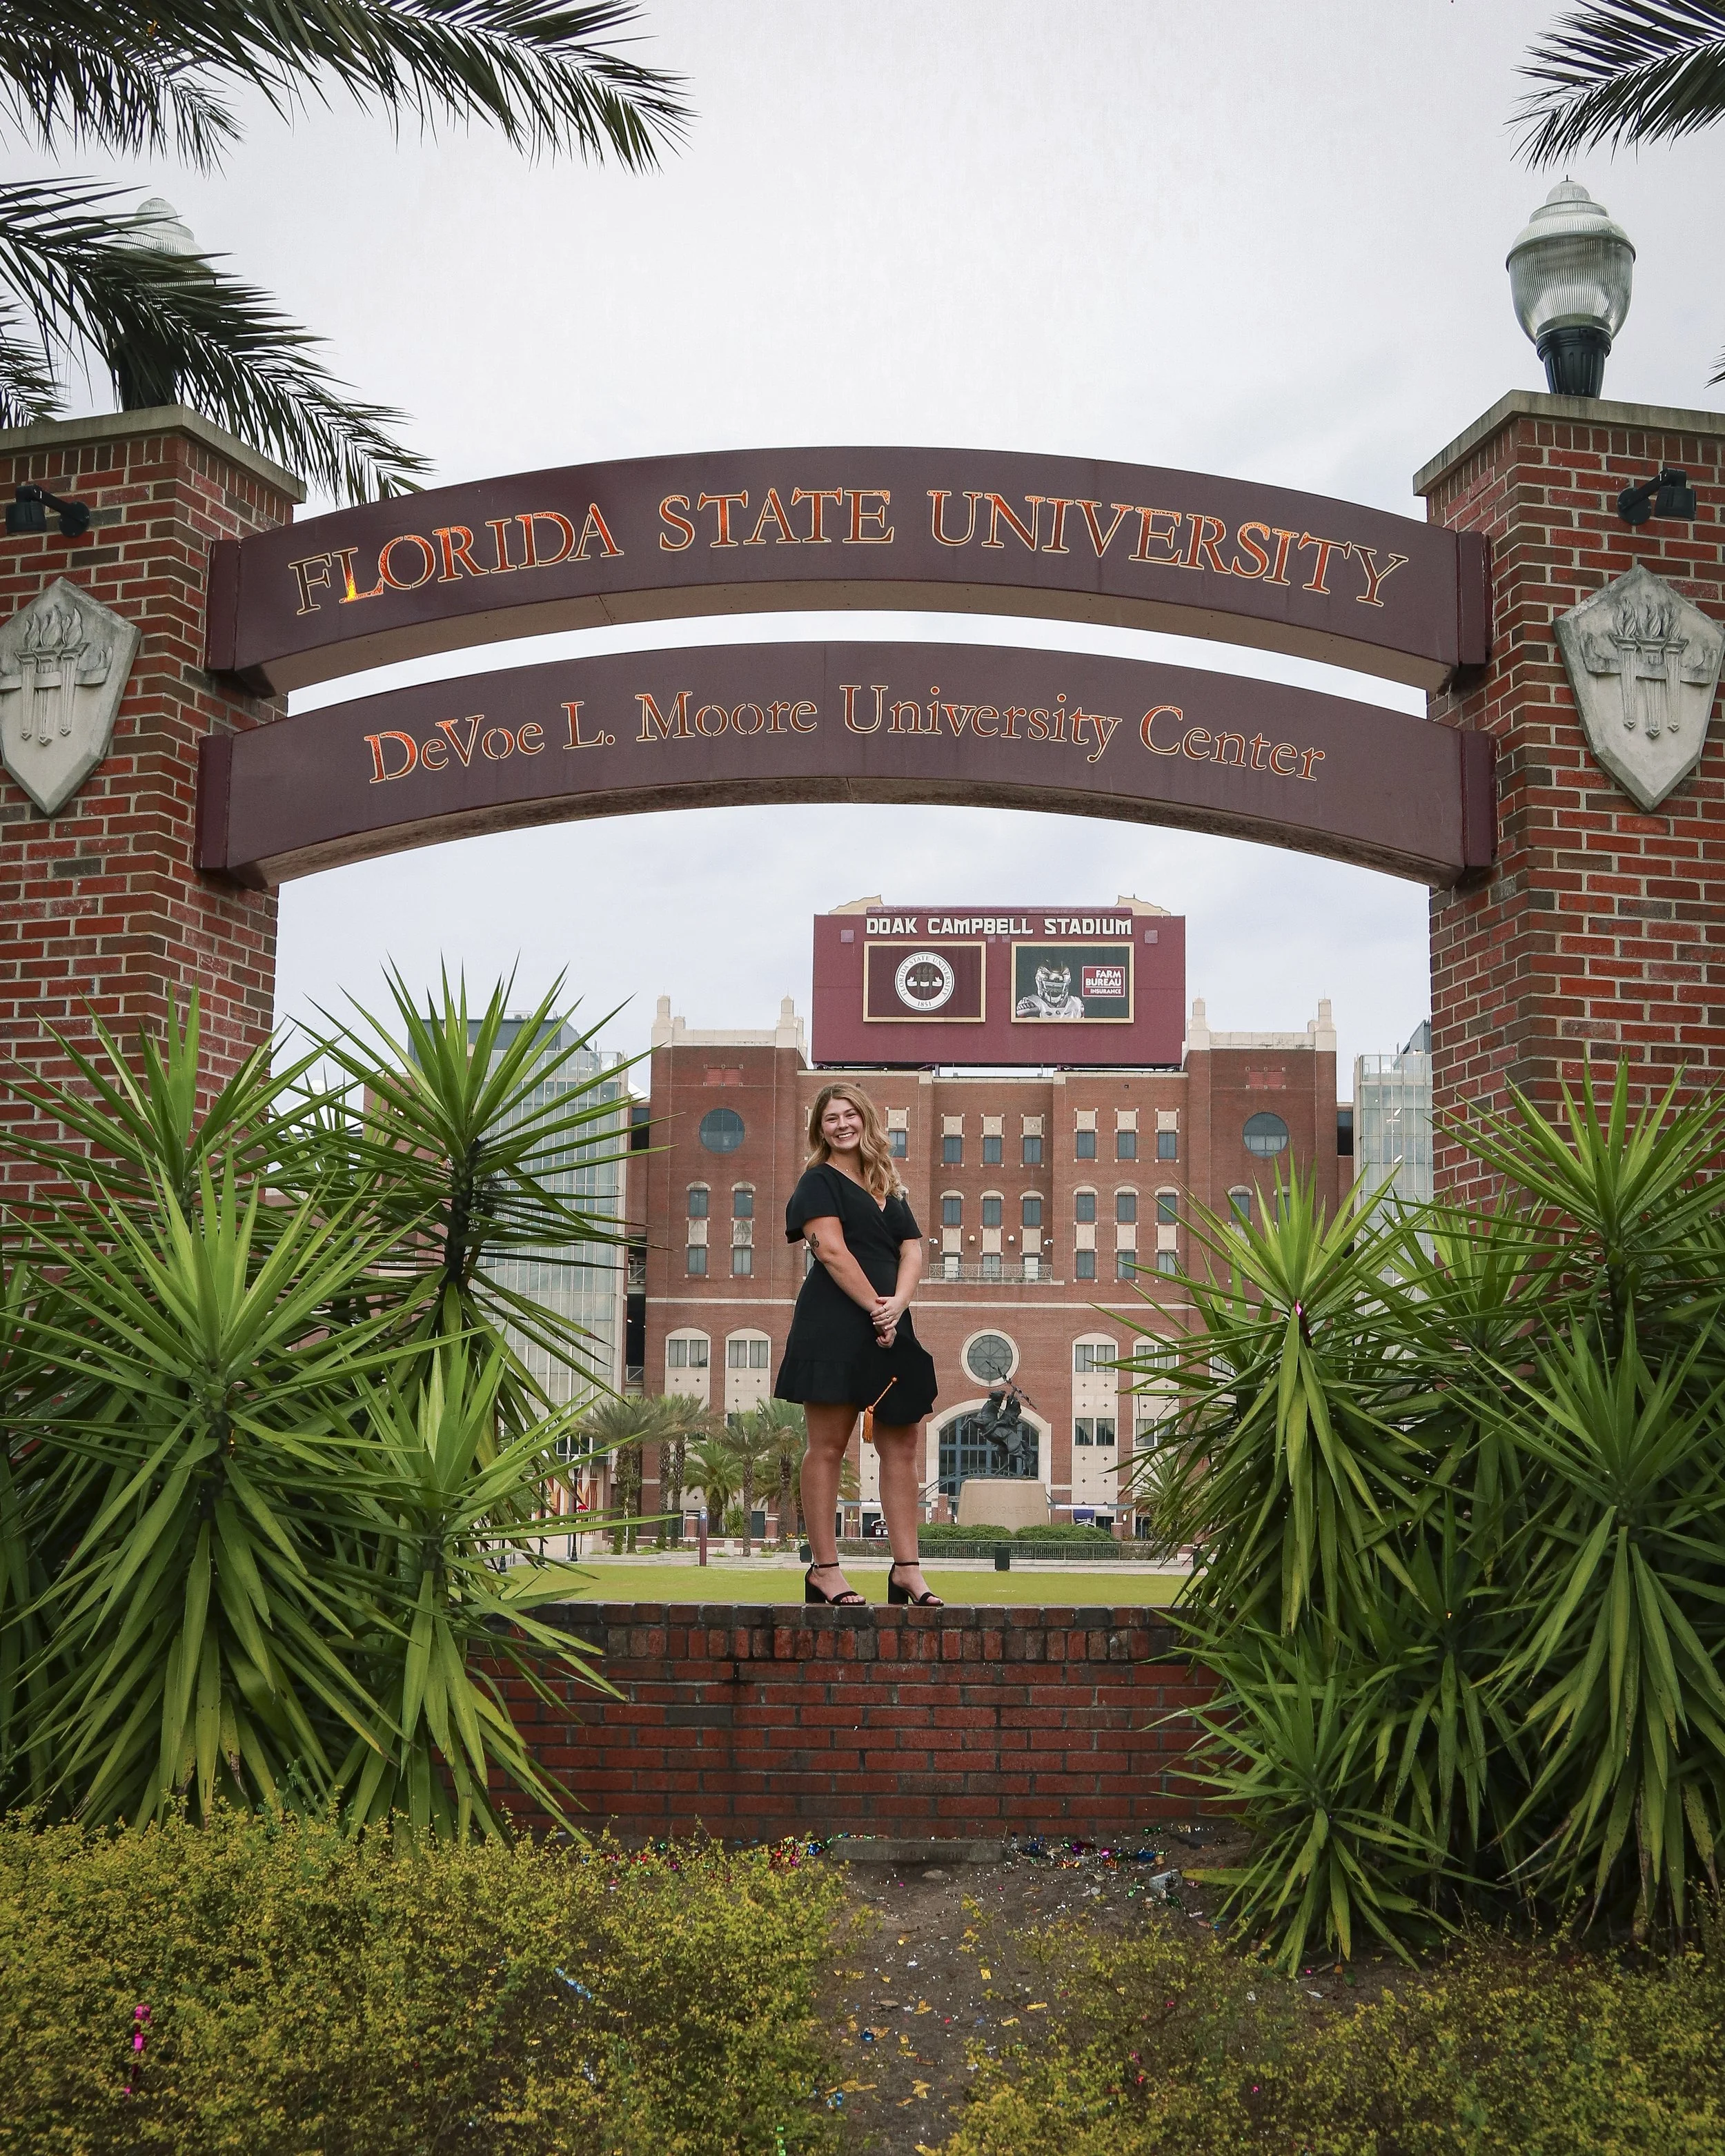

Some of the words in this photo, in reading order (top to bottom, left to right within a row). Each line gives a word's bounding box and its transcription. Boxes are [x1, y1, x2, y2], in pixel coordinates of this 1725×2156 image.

[288, 502, 624, 615] FLORIDA
[658, 487, 896, 551] STATE
[926, 489, 1409, 607] UNIVERSITY
[363, 714, 544, 784] DeVoe
[560, 701, 615, 750] L.
[635, 691, 818, 742] Moore
[839, 684, 1123, 764] University
[1138, 705, 1325, 781] Center
[866, 918, 918, 934] DOAK
[927, 918, 1033, 935] CAMPBELL
[1044, 918, 1132, 935] STADIUM
[899, 965, 909, 996] FLORIDA
[909, 955, 931, 965] STATE
[932, 957, 951, 997] UNIVERSITY
[1085, 978, 1122, 987] BUREAU
[1096, 969, 1122, 978] FARM
